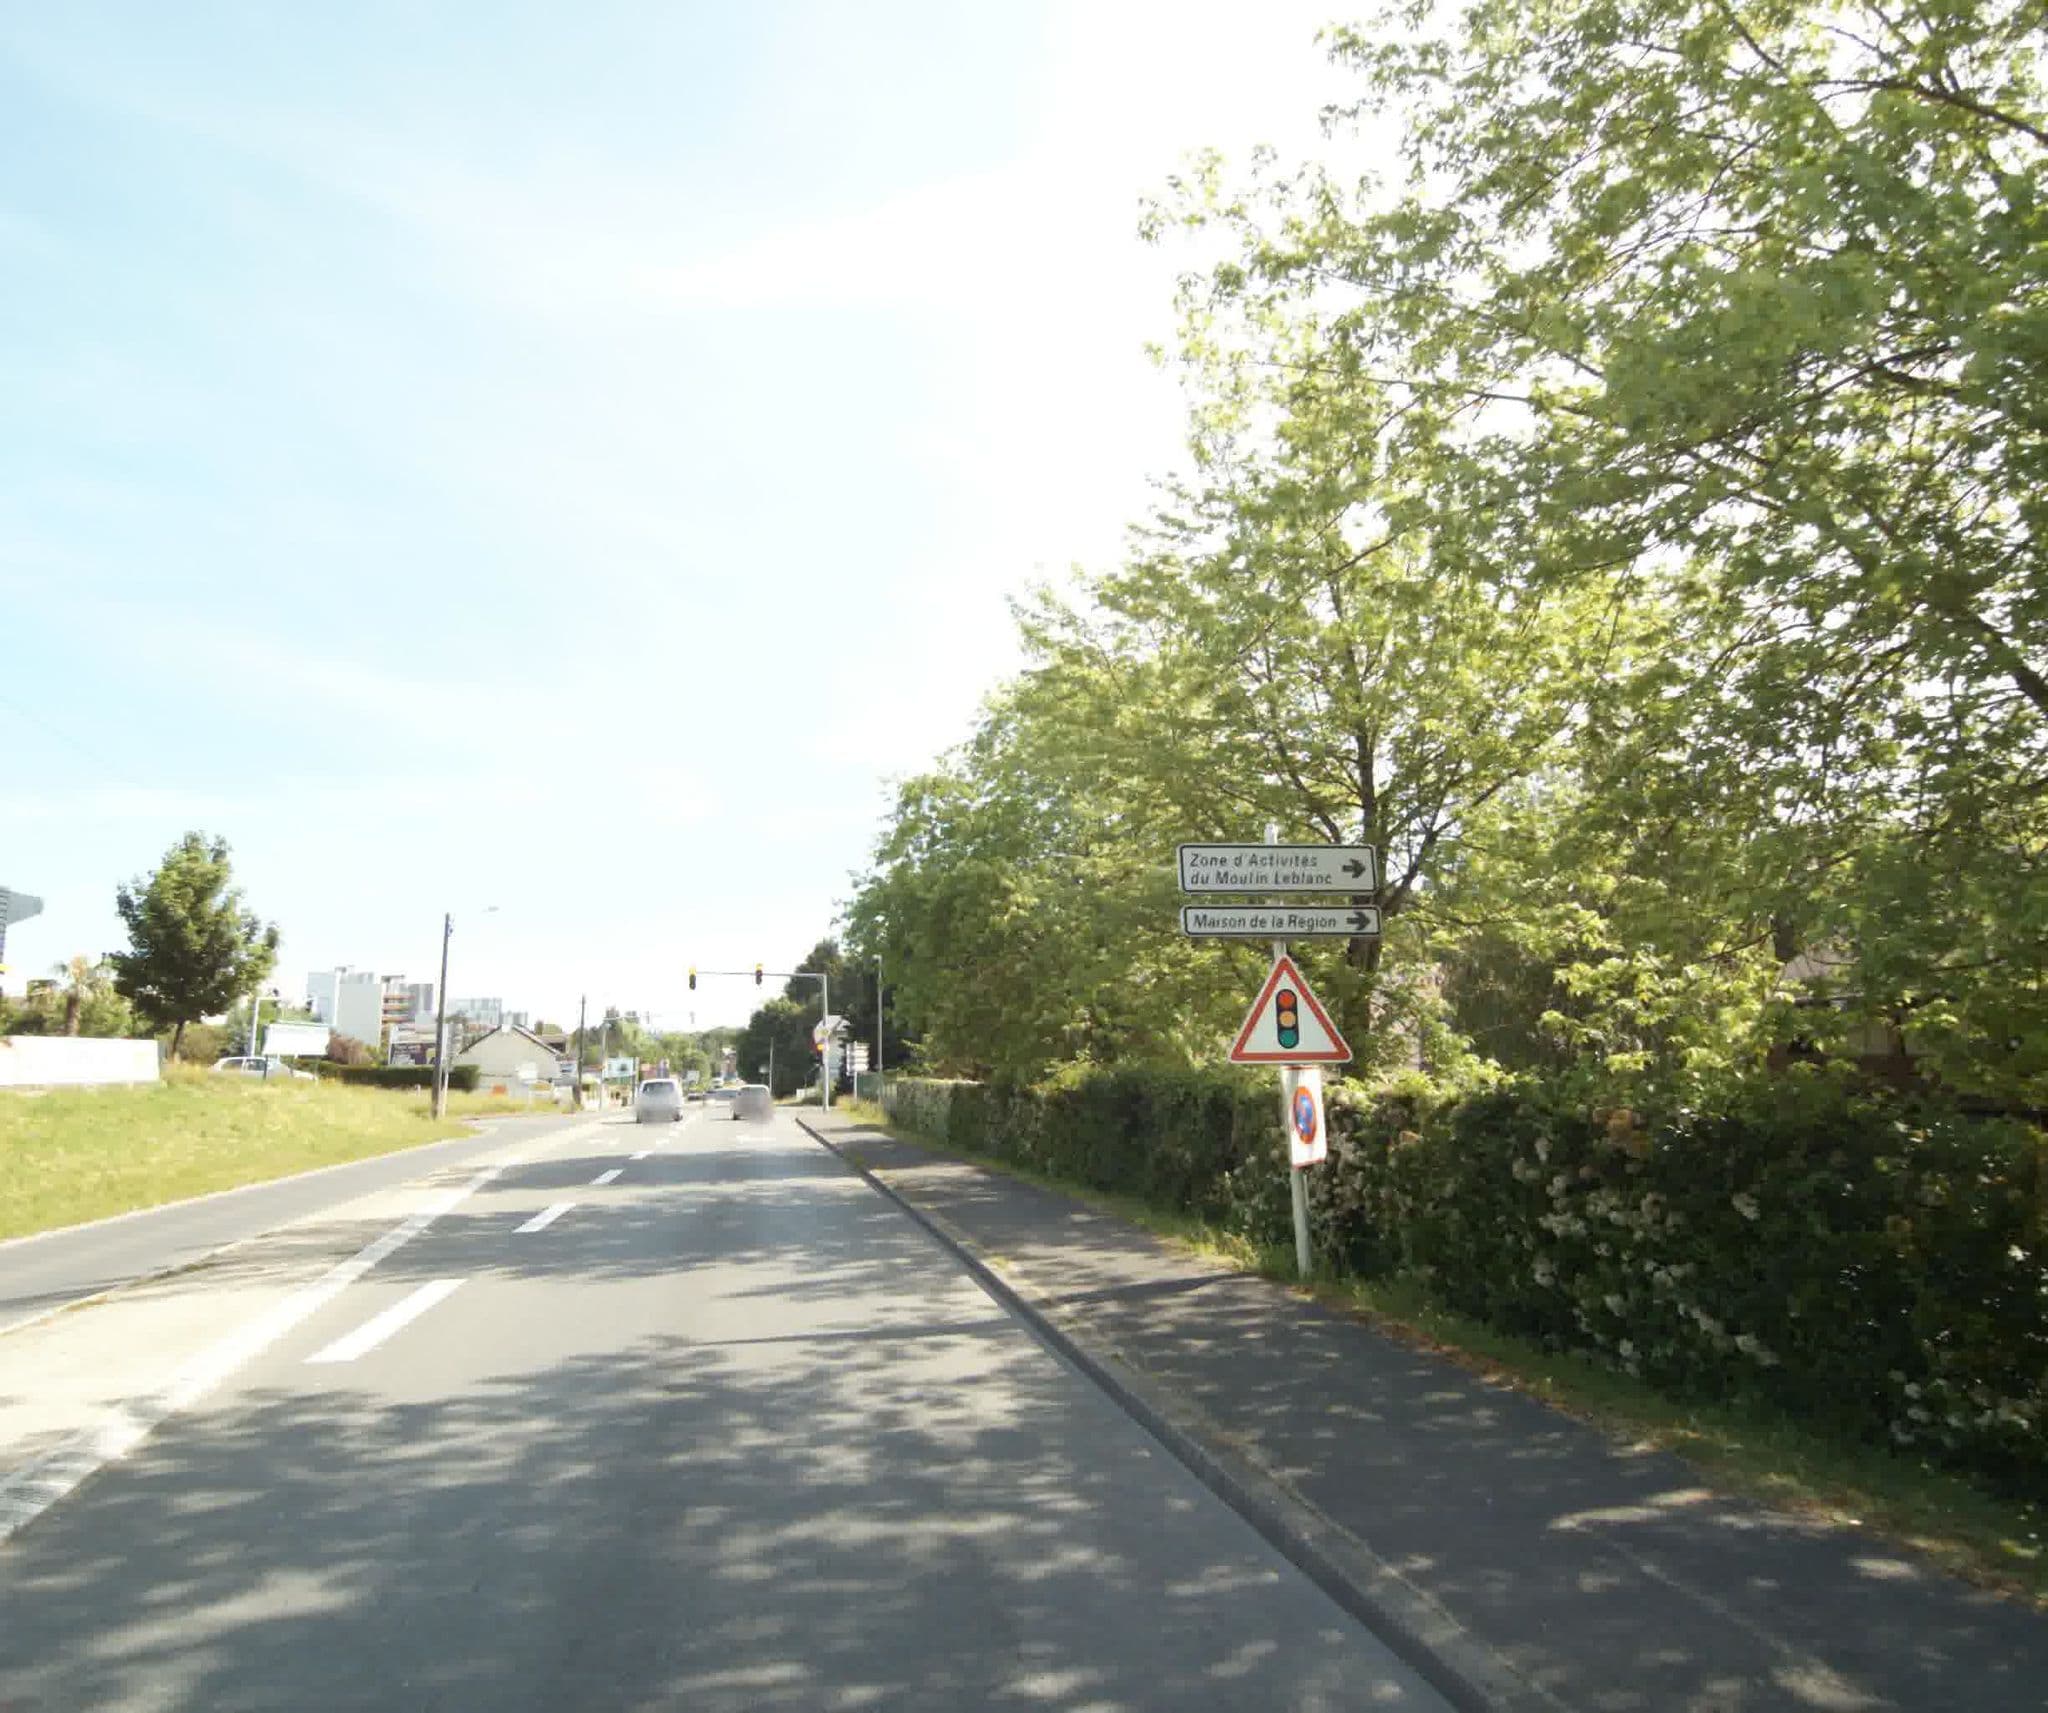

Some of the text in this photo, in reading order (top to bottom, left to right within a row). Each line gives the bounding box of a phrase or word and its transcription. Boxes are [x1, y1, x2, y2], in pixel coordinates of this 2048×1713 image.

[1190, 853, 1227, 868] Zone
[1190, 871, 1333, 885] du Moulin Leblanc
[1193, 914, 1246, 928] Maison
[1250, 915, 1267, 928] de
[1272, 915, 1284, 928] la
